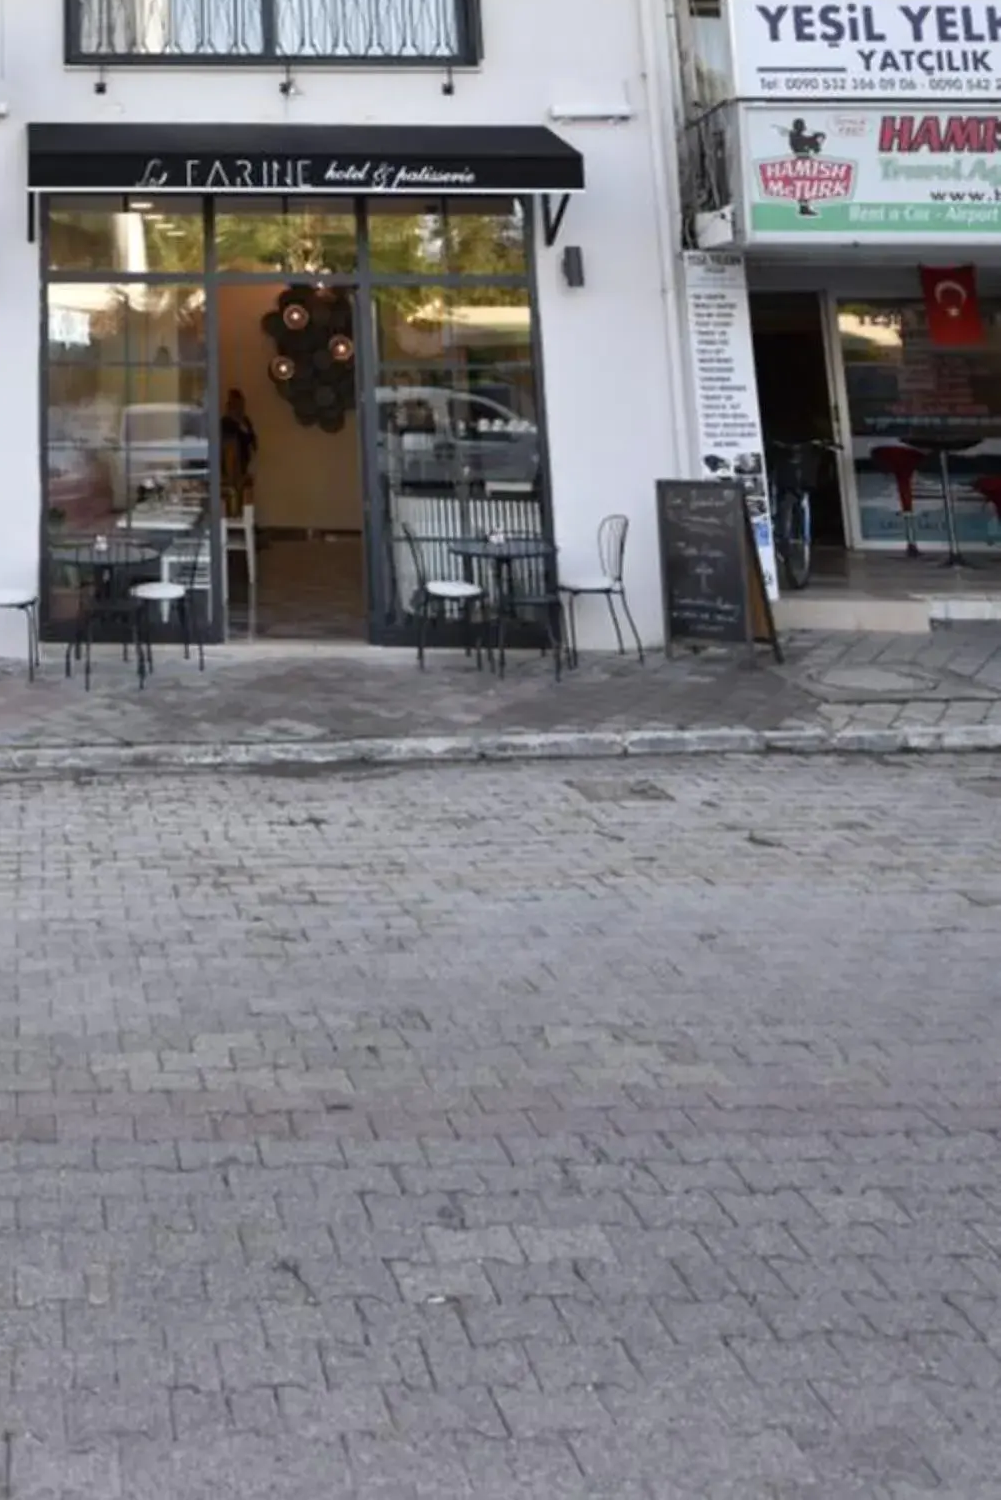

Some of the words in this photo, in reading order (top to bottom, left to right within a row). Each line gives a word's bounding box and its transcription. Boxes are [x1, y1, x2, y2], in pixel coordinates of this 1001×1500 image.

[857, 49, 993, 76] YATÇILIK
[878, 115, 1001, 153] HAMI
[324, 162, 371, 181] hotel
[766, 160, 847, 180] HAMISH
[767, 178, 847, 199] McTURK
